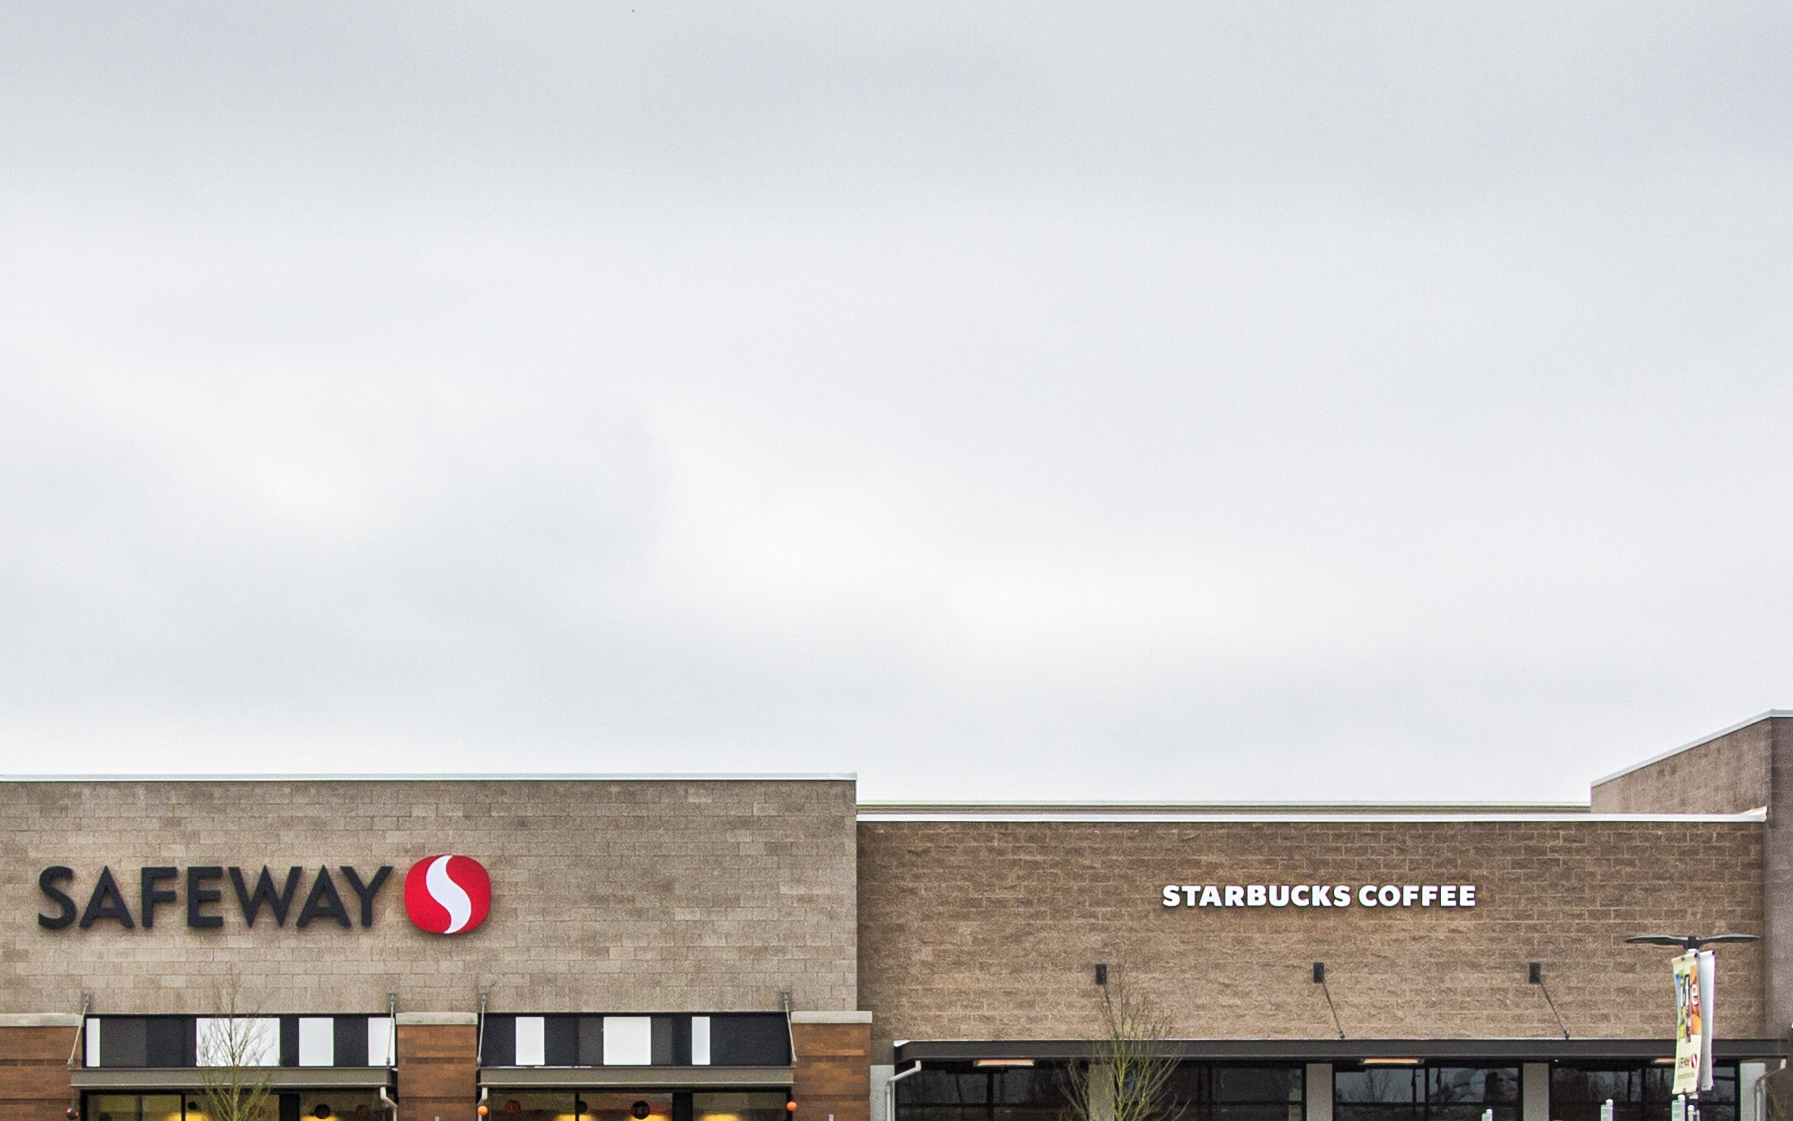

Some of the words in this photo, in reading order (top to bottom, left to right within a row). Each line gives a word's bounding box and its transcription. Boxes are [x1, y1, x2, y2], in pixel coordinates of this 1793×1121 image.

[37, 864, 394, 929] SAFEWAY
[1162, 885, 1352, 907] STARBUCKS
[1358, 885, 1476, 907] COFFEE
